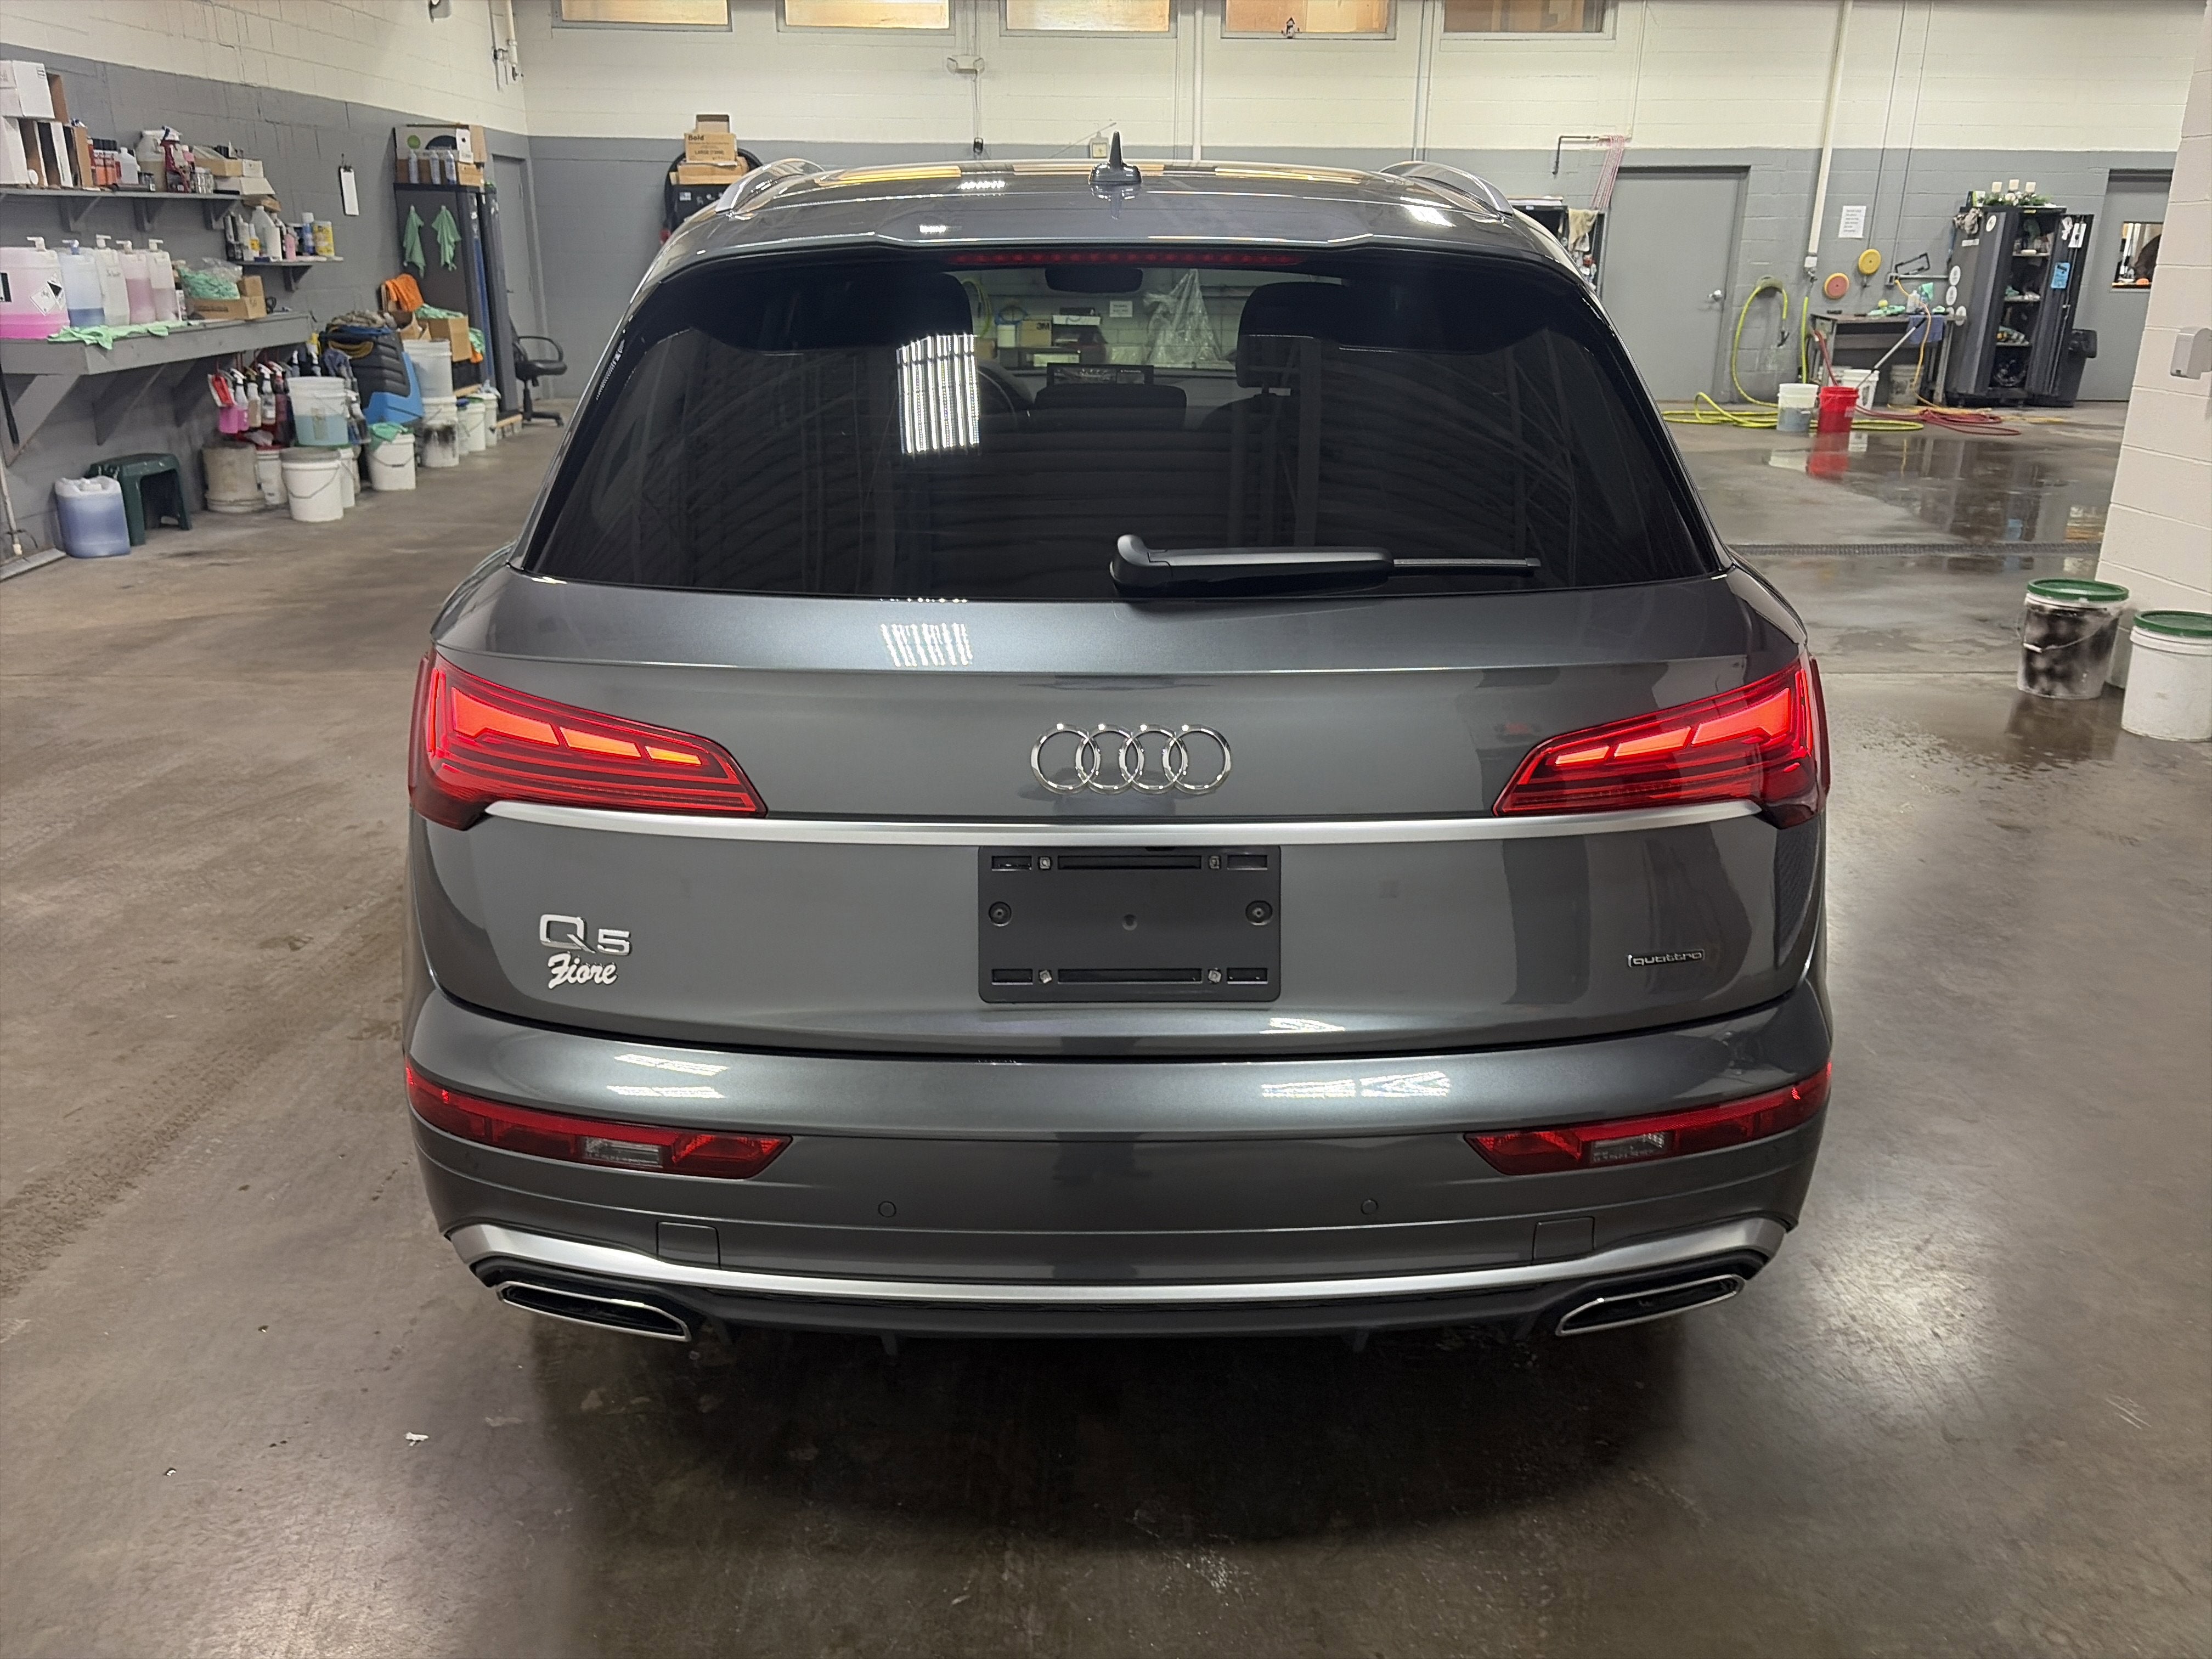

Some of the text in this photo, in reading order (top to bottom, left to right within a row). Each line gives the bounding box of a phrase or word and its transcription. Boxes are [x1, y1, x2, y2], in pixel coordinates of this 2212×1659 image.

[1036, 322, 1049, 330] 3M
[539, 913, 631, 956] Q5
[548, 951, 618, 990] Fiore
[1632, 951, 1702, 966] quattro
